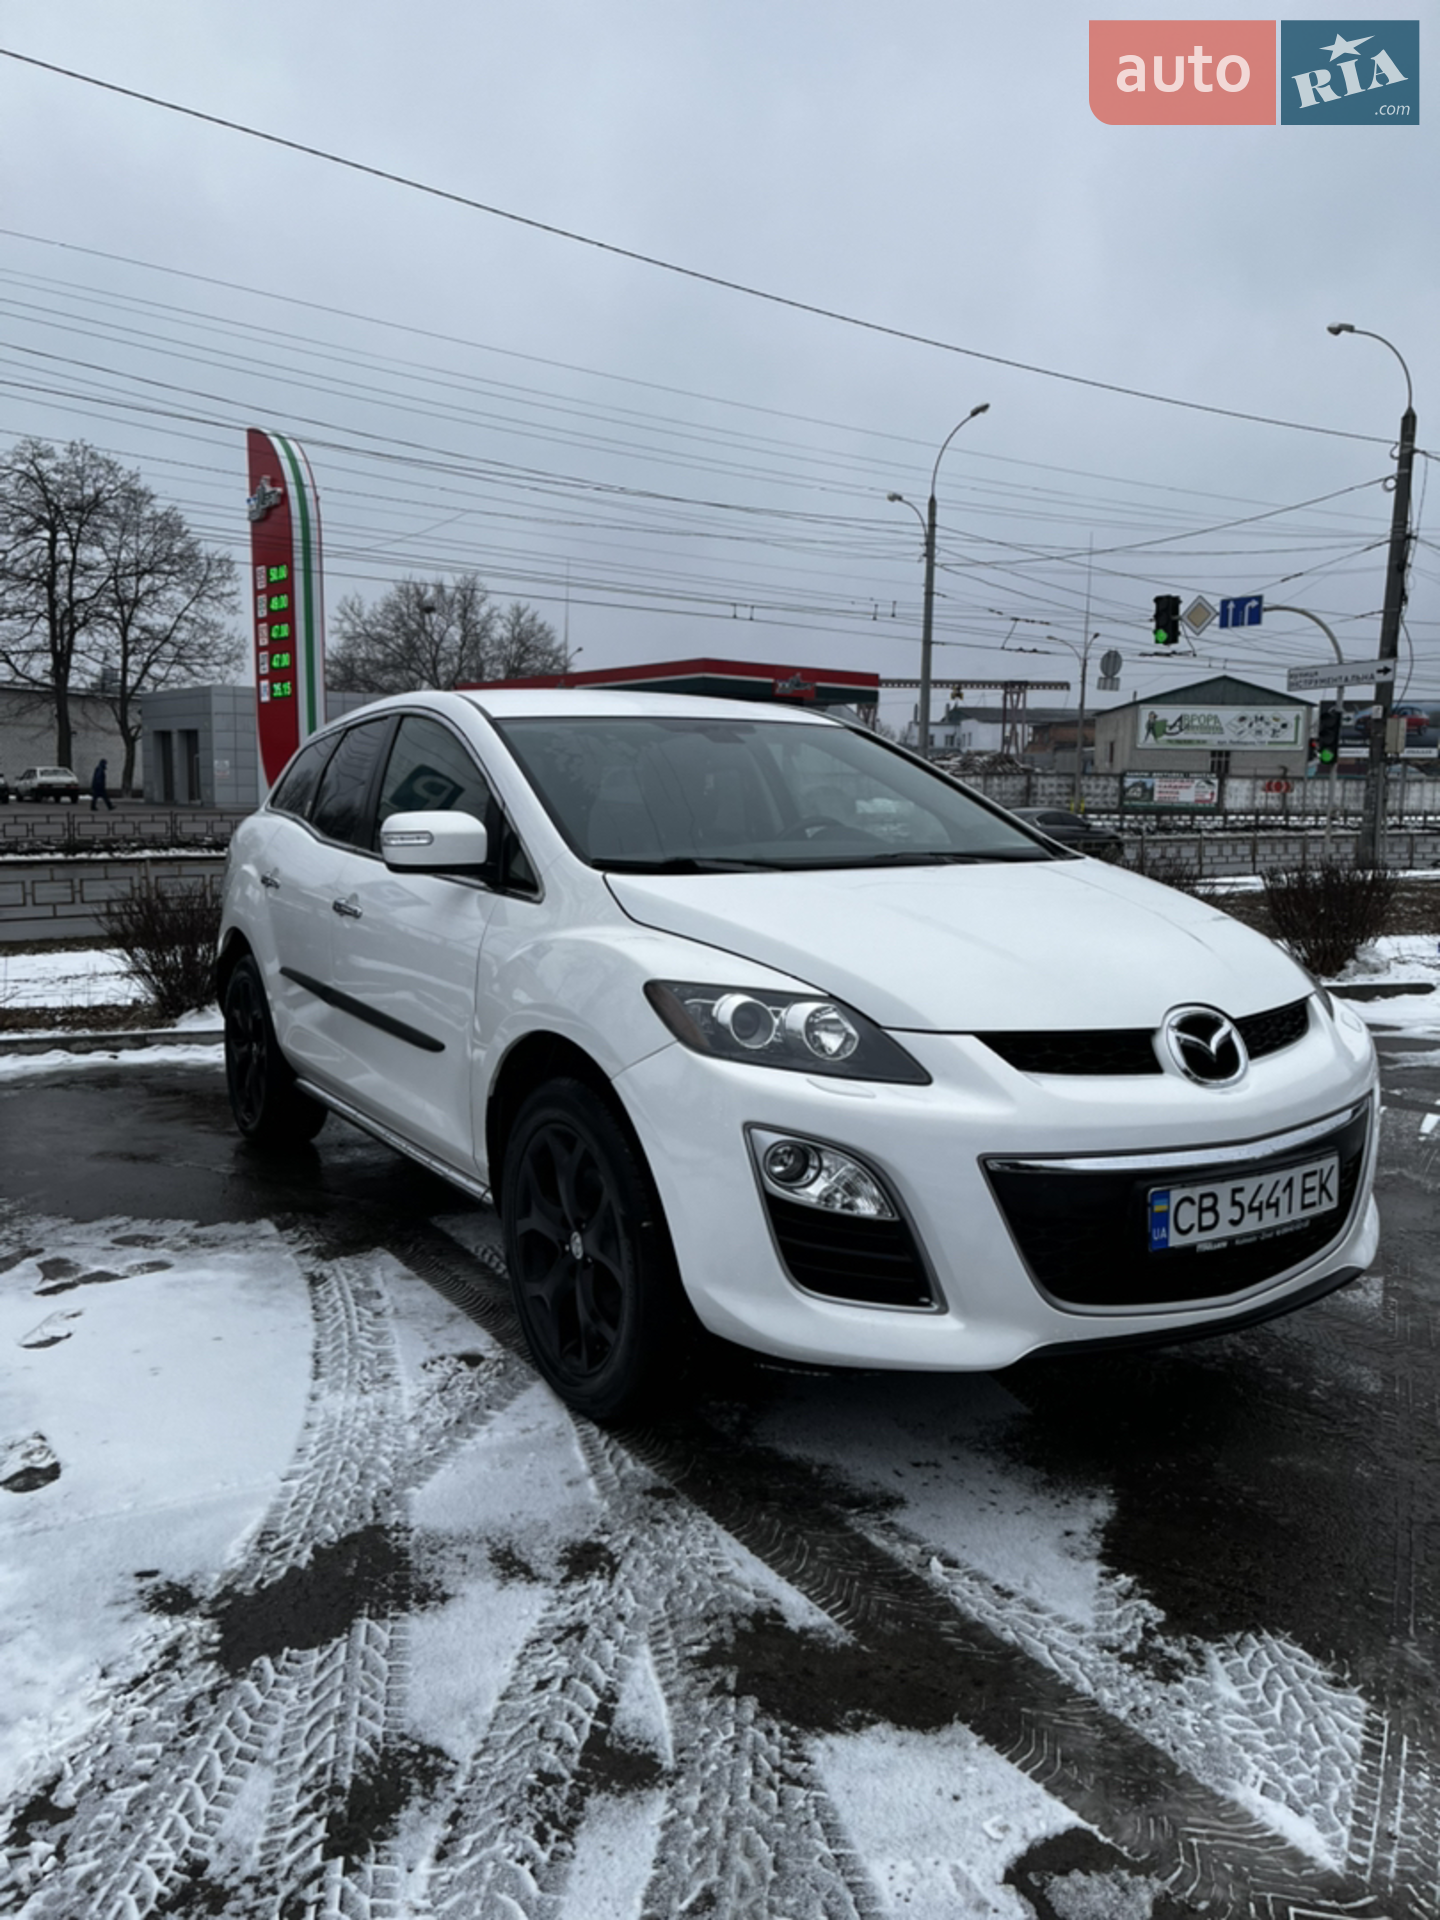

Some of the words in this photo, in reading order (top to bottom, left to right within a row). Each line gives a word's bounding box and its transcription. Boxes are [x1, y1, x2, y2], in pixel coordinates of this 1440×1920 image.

[1173, 1191, 1220, 1235] CB
[1228, 1177, 1294, 1227] 5441
[1301, 1164, 1336, 1210] EK
[1152, 1227, 1168, 1241] UA
